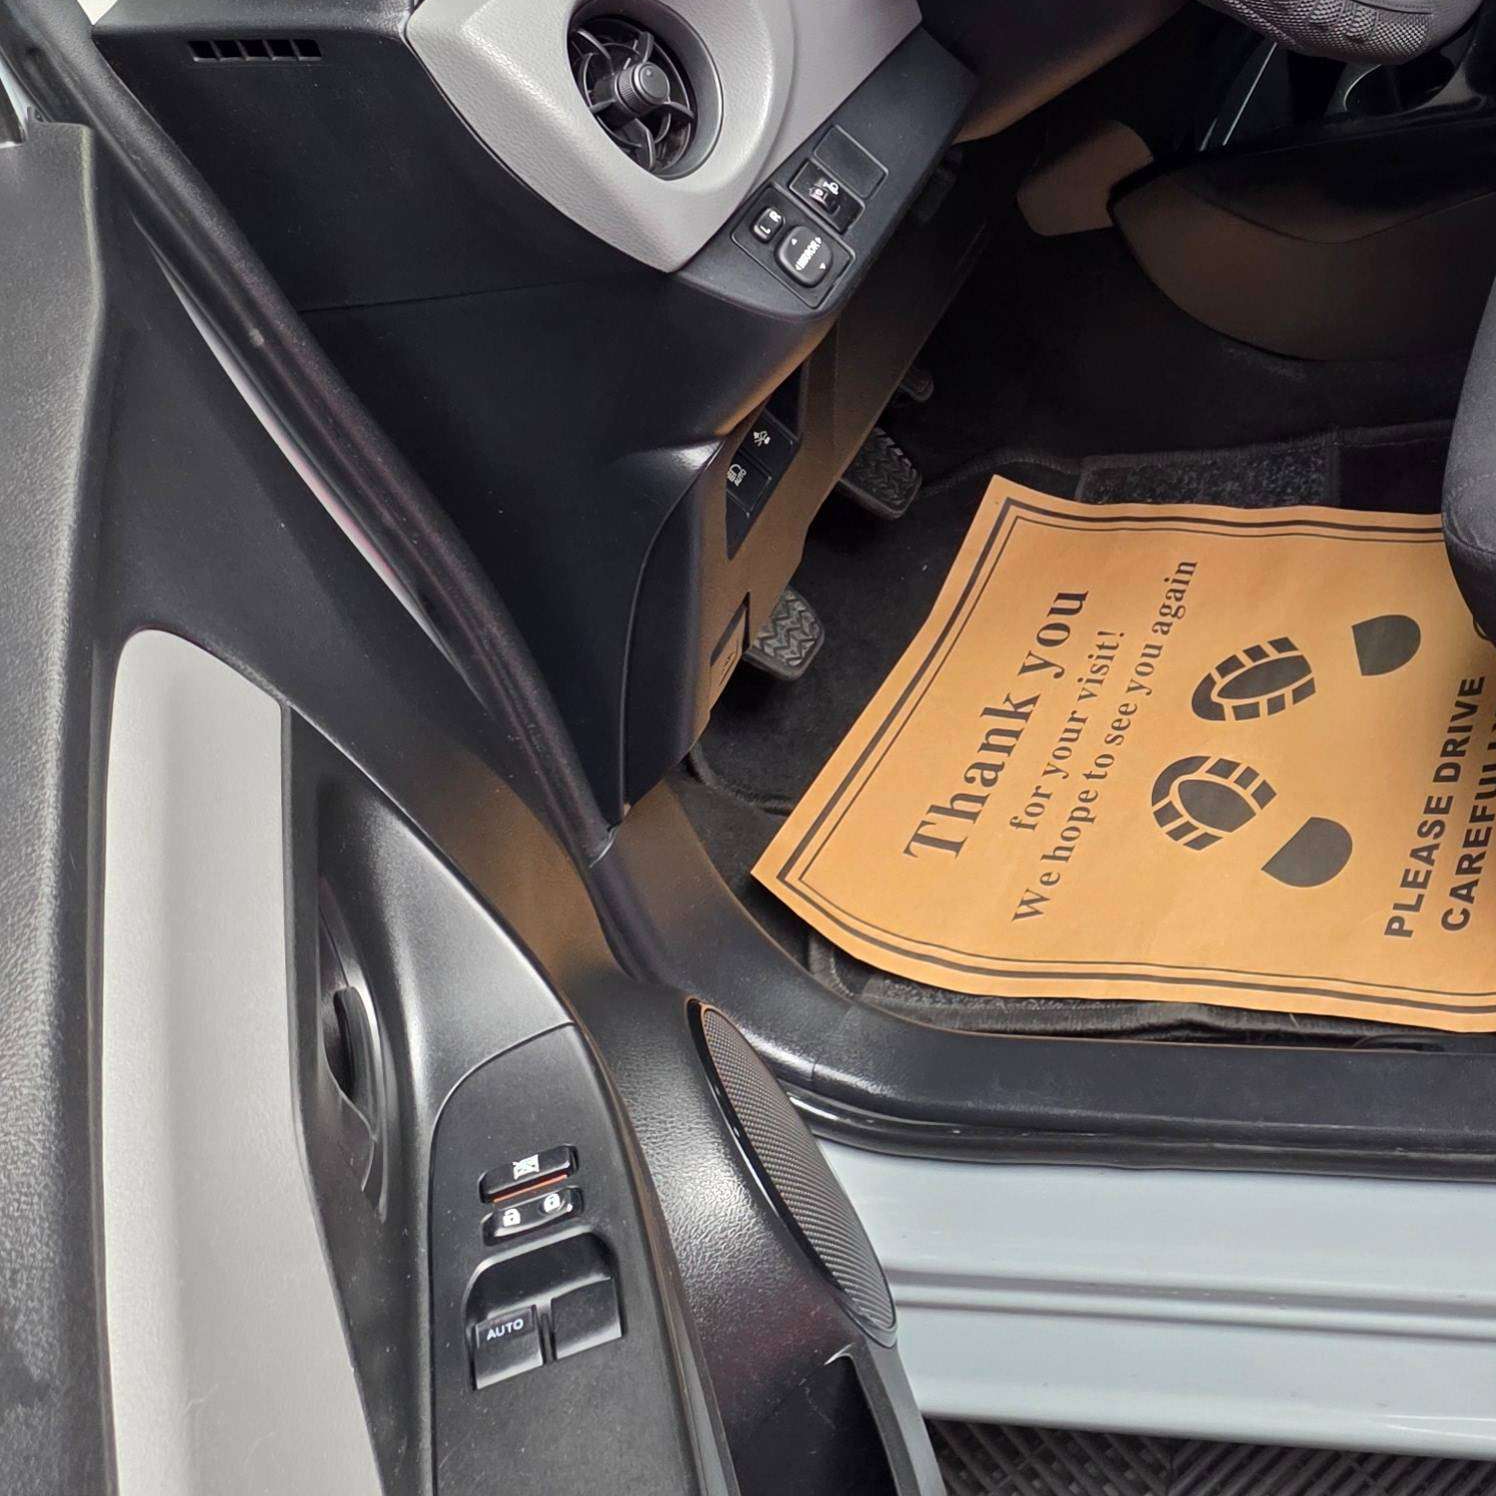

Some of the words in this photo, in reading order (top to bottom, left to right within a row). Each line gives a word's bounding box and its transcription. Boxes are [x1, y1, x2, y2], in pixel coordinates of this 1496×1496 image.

[760, 225, 771, 235] L
[770, 210, 782, 222] R
[795, 240, 821, 269] MIRROR
[903, 693, 1041, 861] Thank
[1018, 591, 1089, 680] you
[1009, 785, 1053, 835] for
[1041, 710, 1089, 779] your
[1077, 630, 1126, 702] visit!
[1012, 871, 1062, 922] We
[1040, 788, 1100, 863] hope
[1082, 753, 1115, 780] to
[1104, 702, 1139, 746] see
[1125, 643, 1165, 693] you
[1152, 561, 1198, 636] again
[1383, 795, 1455, 939] PLEASE
[1431, 676, 1487, 784] DRIVE
[487, 1318, 524, 1341] AUTO
